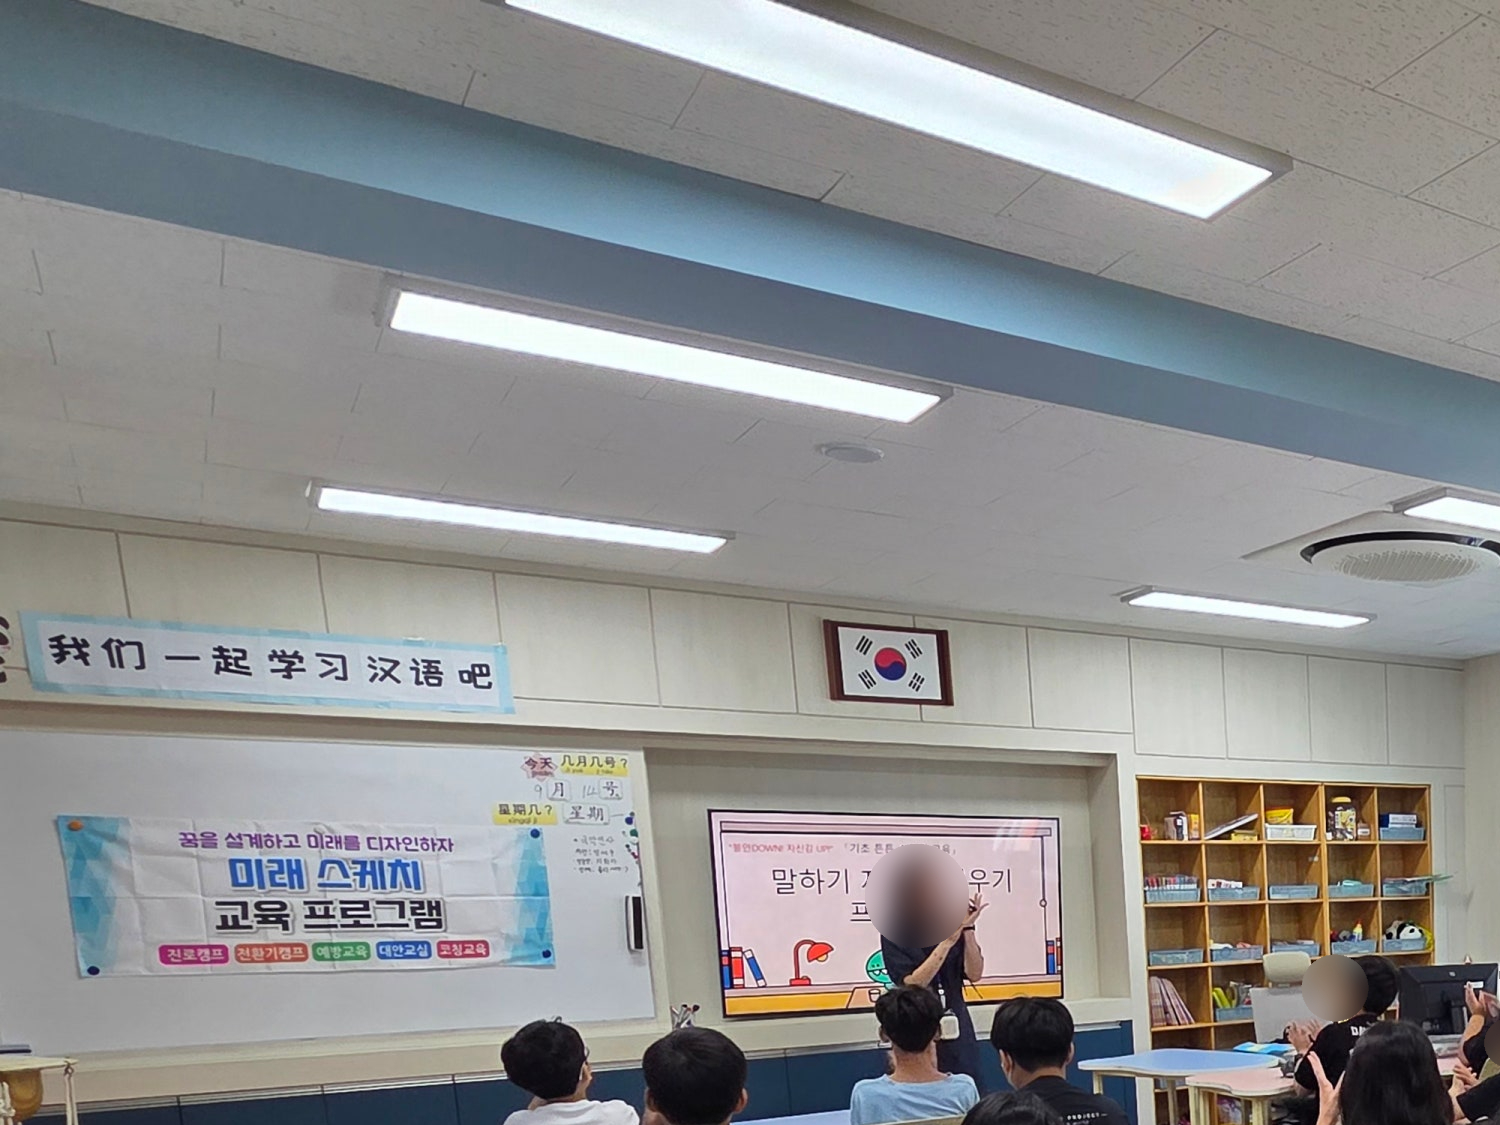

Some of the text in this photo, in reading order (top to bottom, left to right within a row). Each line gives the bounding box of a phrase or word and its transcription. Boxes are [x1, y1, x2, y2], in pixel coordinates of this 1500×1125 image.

[48, 634, 493, 690] 我们一起学习汉语吧
[525, 757, 553, 770] 今天
[552, 781, 564, 797] 月
[178, 831, 455, 853] 꿈을 설계하고 미래를 디자인하자
[228, 858, 422, 891] 미래 스케치
[772, 869, 849, 894] 말하기
[215, 900, 443, 931] 교육 프로그램
[167, 947, 224, 962] 진로캠프
[237, 946, 306, 961] 전환기캠프
[316, 944, 369, 959] 예방교육
[379, 943, 430, 956] 대안교실
[439, 942, 487, 956] 코칭교육
